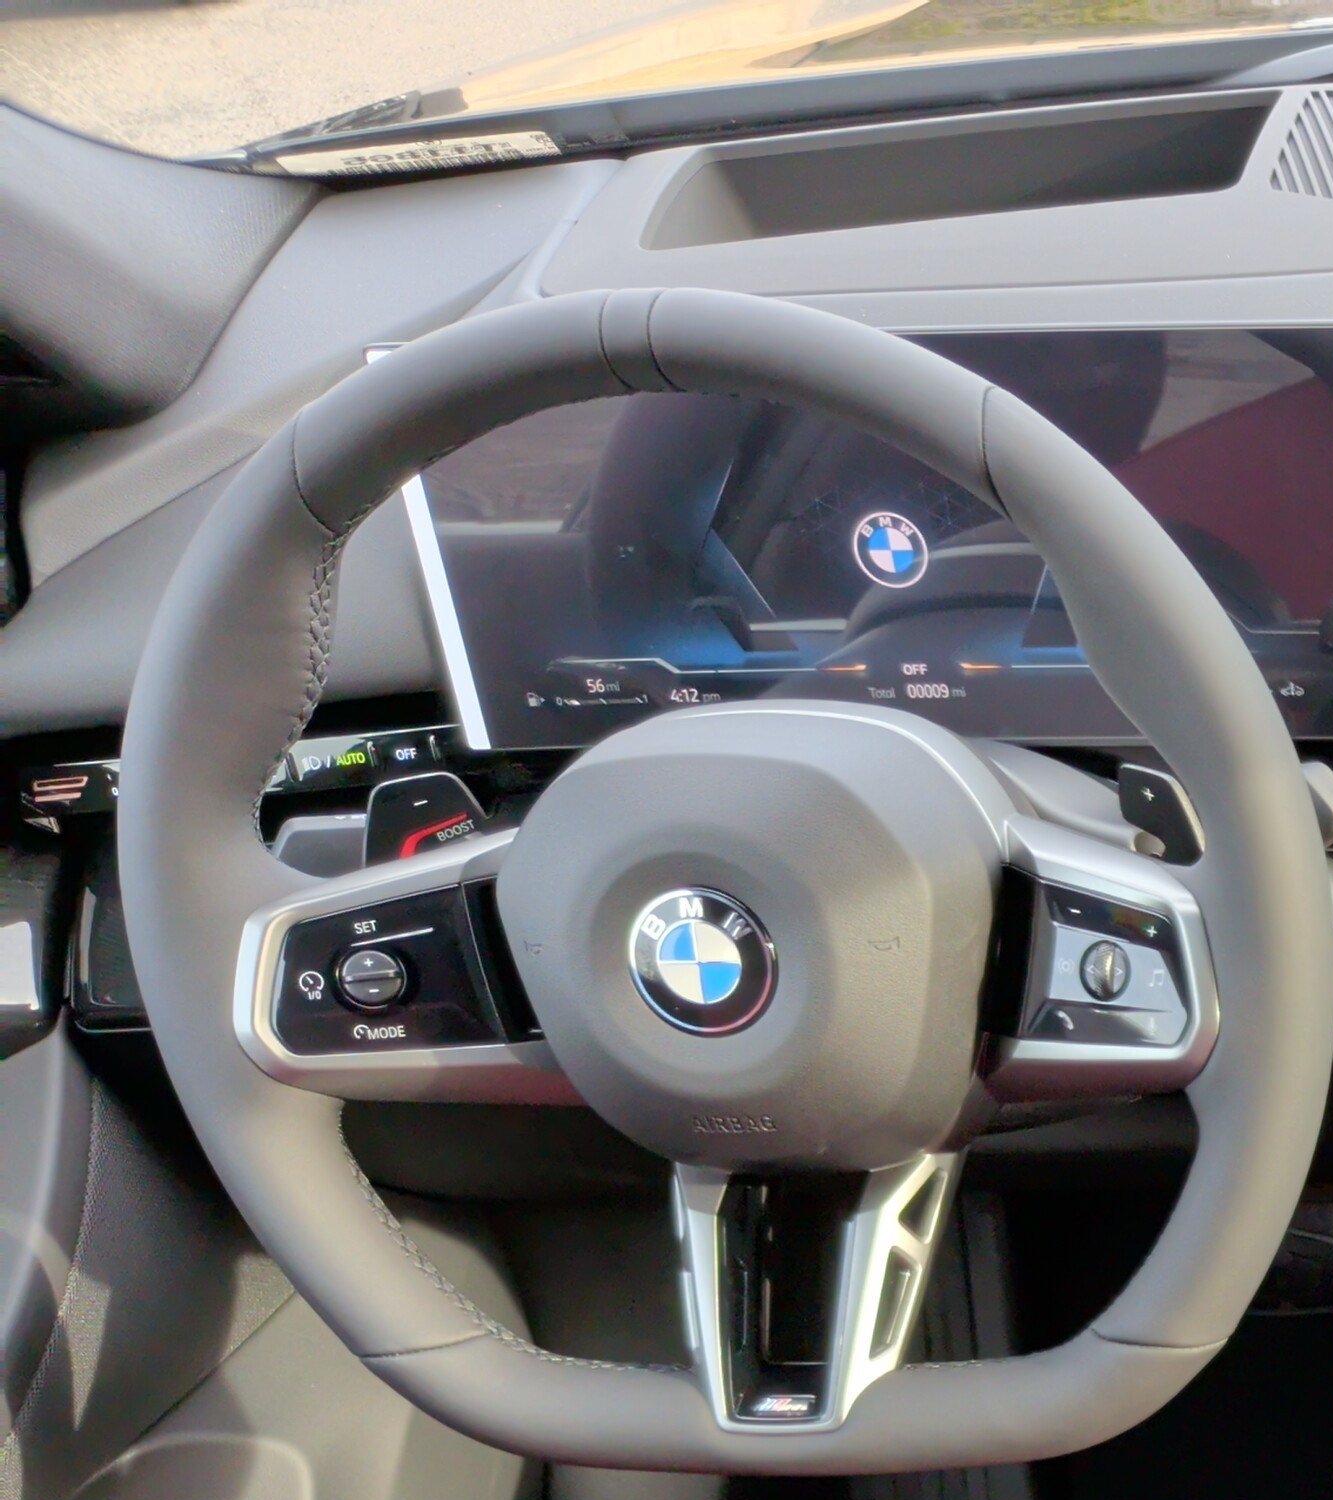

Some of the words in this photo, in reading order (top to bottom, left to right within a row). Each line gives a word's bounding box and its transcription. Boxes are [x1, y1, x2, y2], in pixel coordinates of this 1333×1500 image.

[860, 516, 914, 538] BMW
[902, 664, 927, 676] OFF
[586, 678, 605, 693] 56
[606, 682, 620, 692] mi
[868, 687, 896, 698] Total
[907, 684, 949, 699] 00009
[952, 687, 966, 698] mi
[670, 688, 700, 703] 4:12
[336, 752, 366, 766] AUTO
[396, 748, 417, 760] OFF
[436, 819, 476, 842] BOOST
[640, 897, 753, 940] BMW
[354, 920, 377, 934] SET
[367, 1025, 406, 1040] MODE
[692, 1115, 776, 1134] AIRBAG
